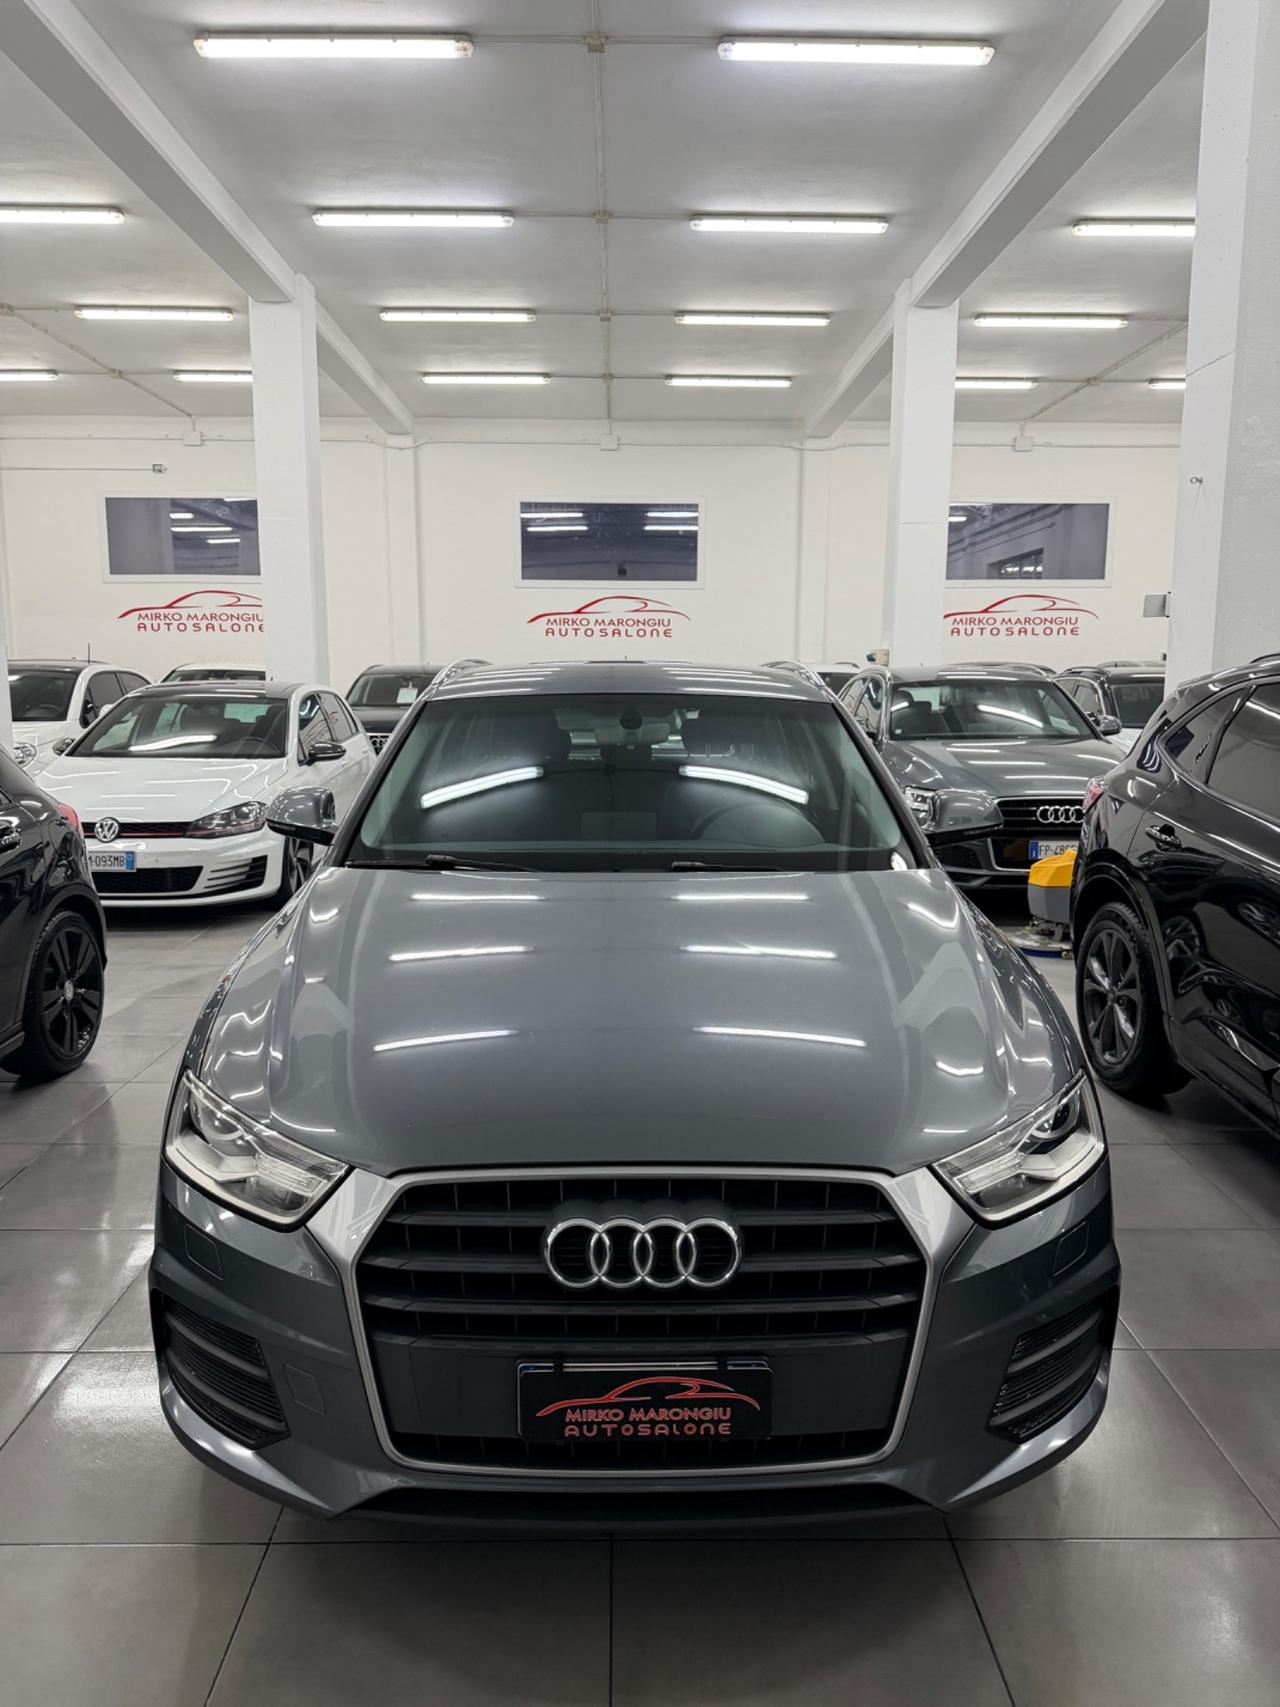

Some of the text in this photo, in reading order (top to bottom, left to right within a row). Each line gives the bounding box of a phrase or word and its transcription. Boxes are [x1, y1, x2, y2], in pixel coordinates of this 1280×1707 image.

[138, 612, 264, 622] MIRKO MARONGIU
[546, 617, 671, 628] MIRKO MARONGIU
[952, 616, 1079, 626] MIRKO MARONGIU
[545, 628, 673, 638] AUTOSALONE
[950, 626, 1080, 637] AUTOSALONE
[565, 1407, 731, 1422] MIRKO MARONGIU
[564, 1423, 731, 1437] AUTOSALONE
